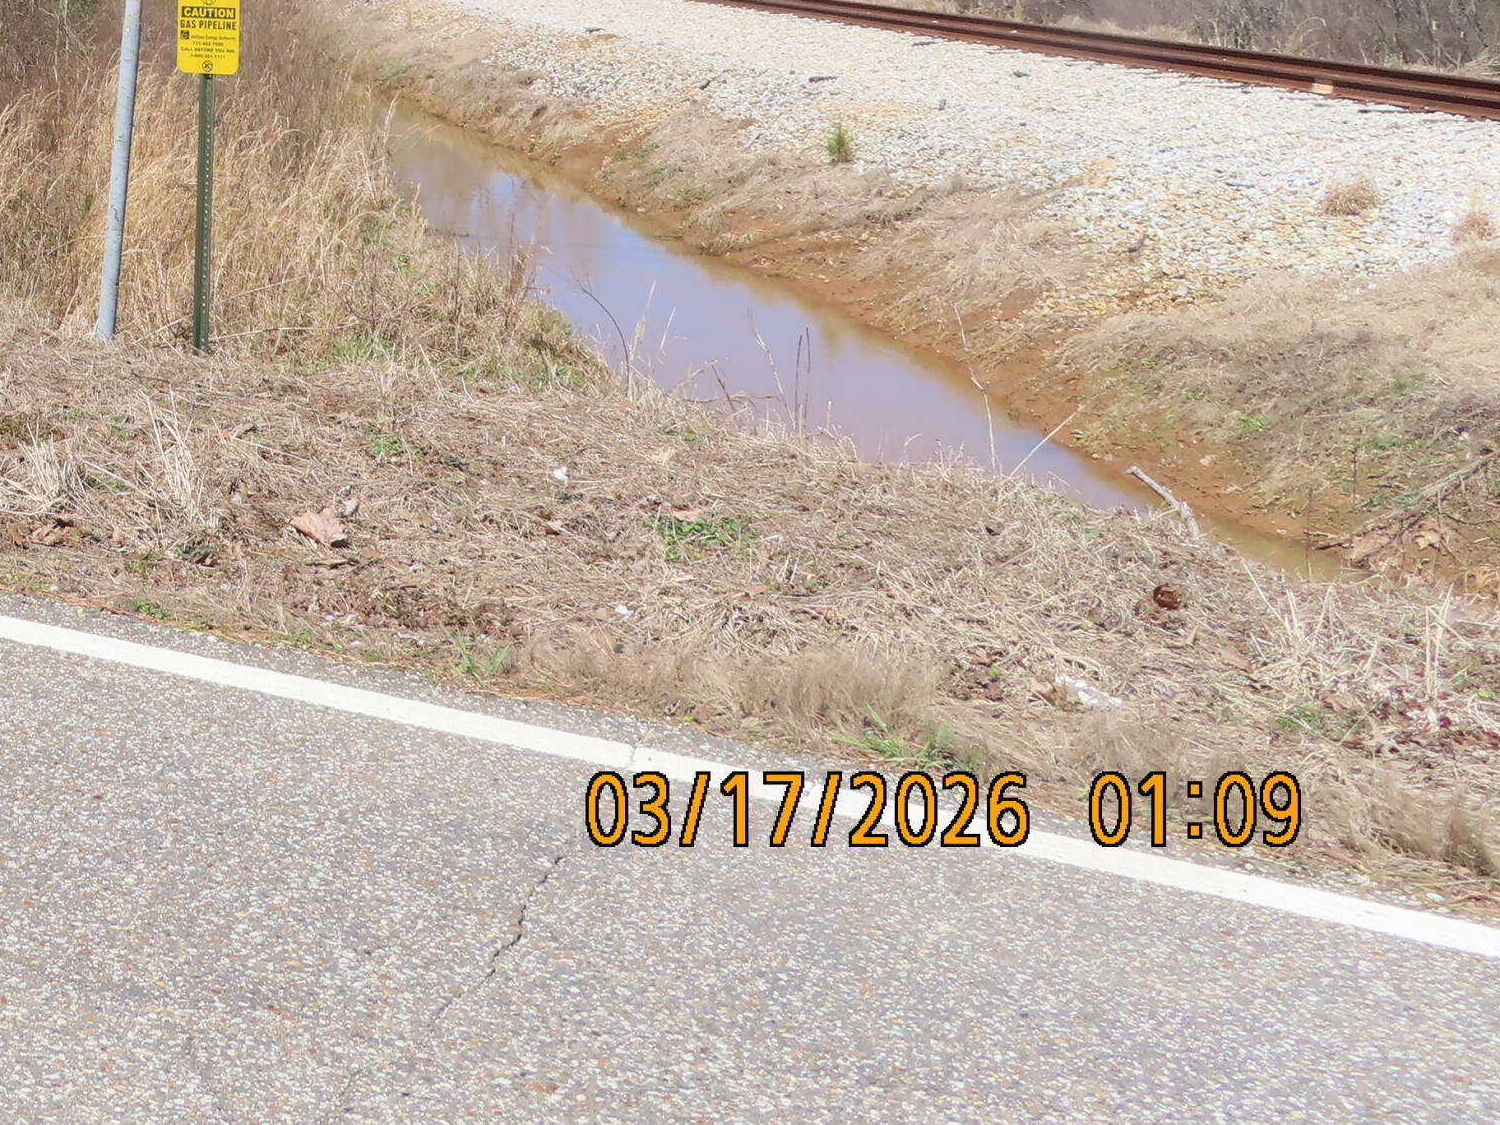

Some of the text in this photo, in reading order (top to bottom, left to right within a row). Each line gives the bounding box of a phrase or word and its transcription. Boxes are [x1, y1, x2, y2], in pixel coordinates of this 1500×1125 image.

[183, 7, 234, 18] CAUTION
[180, 19, 237, 30] GAS PIPELINE
